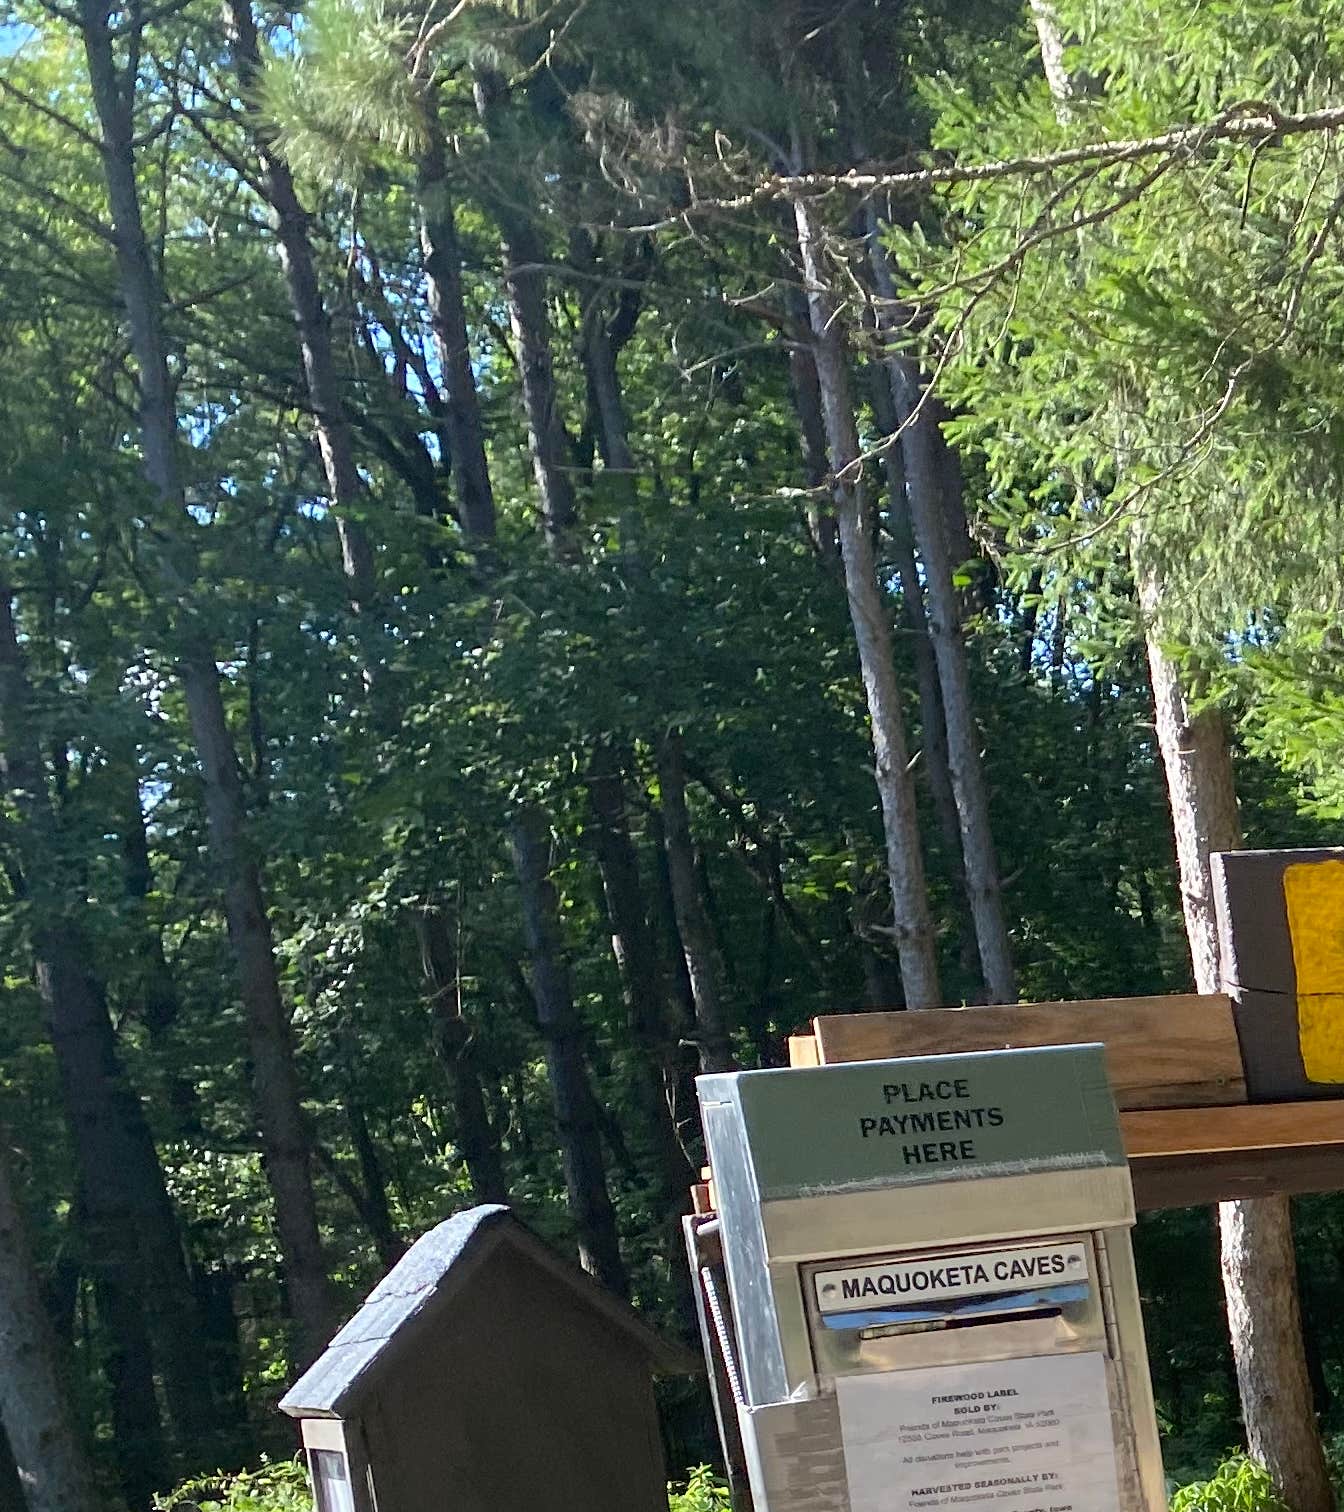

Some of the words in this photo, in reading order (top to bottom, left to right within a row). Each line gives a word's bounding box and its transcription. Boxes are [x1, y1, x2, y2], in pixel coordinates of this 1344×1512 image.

[883, 1079, 970, 1104] PLACE
[860, 1107, 1004, 1138] PAYMENTS
[902, 1140, 976, 1164] HERE
[841, 1264, 989, 1299] MAQUOKETA
[994, 1254, 1065, 1280] CAVES
[932, 1391, 985, 1404] FIREWOOD
[987, 1388, 1019, 1398] LABEL
[954, 1405, 981, 1415] SOLD
[911, 1482, 972, 1496] HARVESTED
[974, 1473, 1039, 1489] SEASONALLY
